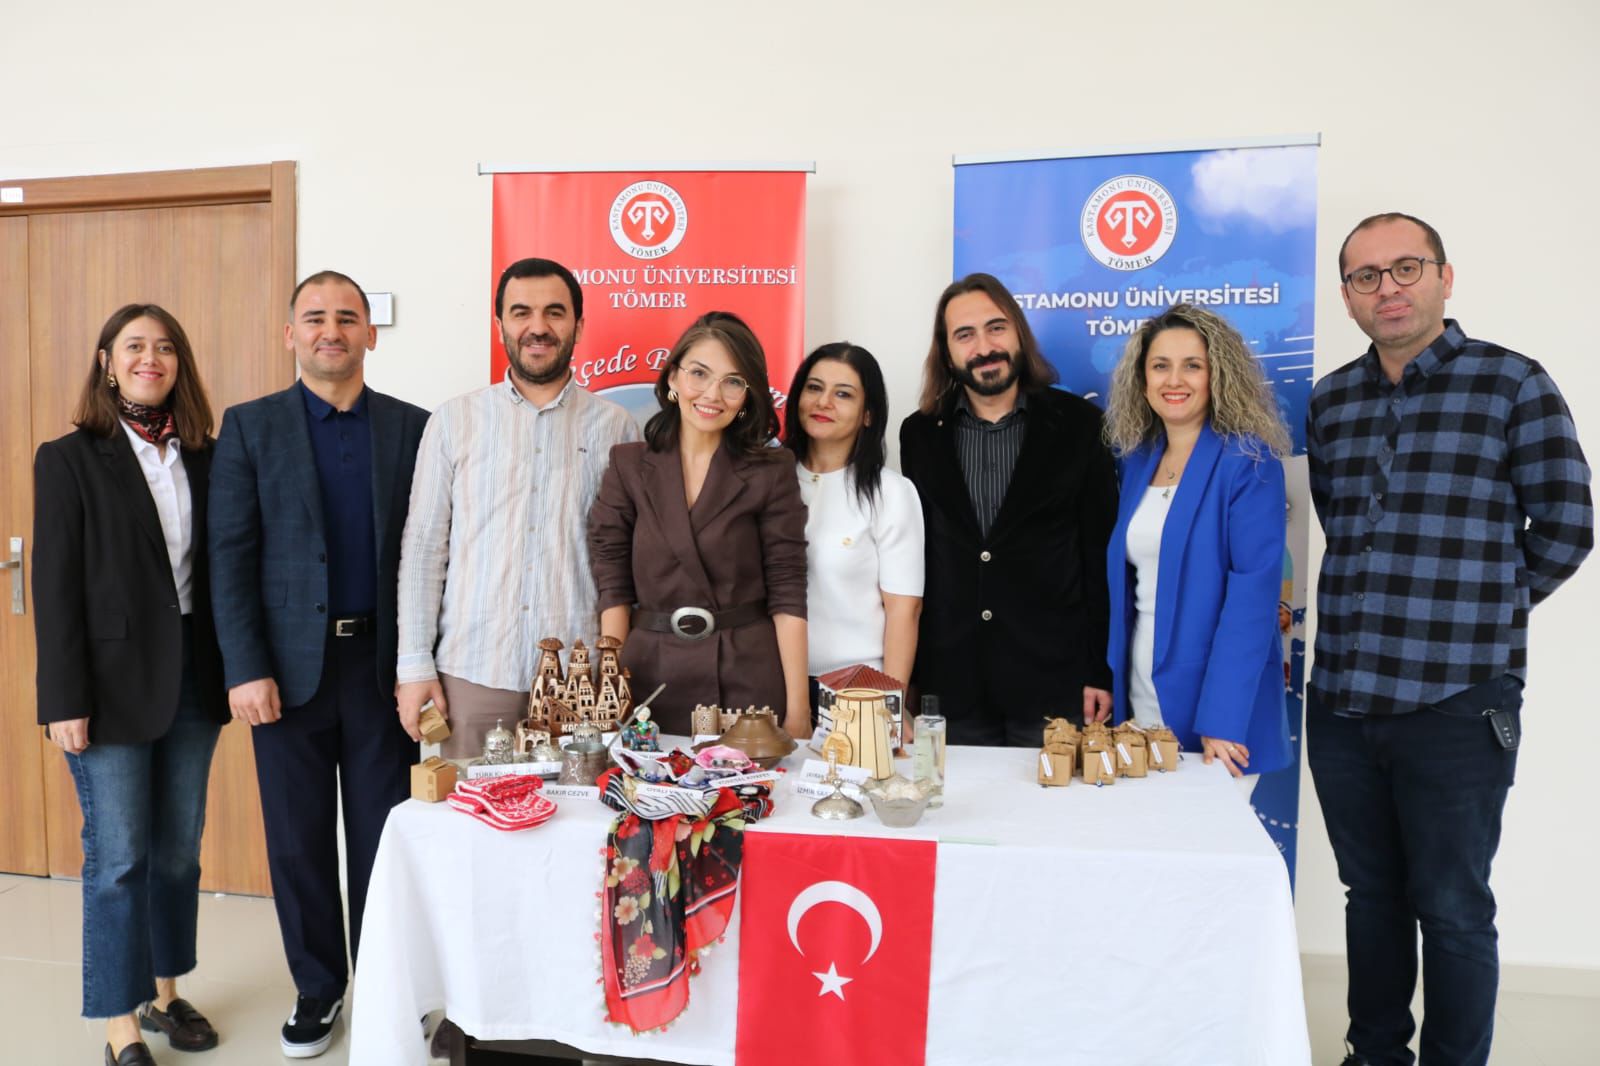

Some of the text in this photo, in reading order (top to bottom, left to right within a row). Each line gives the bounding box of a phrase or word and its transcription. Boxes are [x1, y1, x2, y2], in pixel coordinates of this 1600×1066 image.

[612, 184, 643, 230] KASTAMONU
[1087, 179, 1173, 237] KASTAMONU ÜNİVERSİTESİ
[631, 246, 668, 257] TÖMER
[1108, 255, 1153, 269] TÖMER
[643, 265, 798, 285] ÜNİVERSİTESİ
[609, 289, 687, 308] TÖMER
[1013, 282, 1280, 310] STAMONU ÜNİVERSİTESİ
[1086, 315, 1147, 336] TÖM
[572, 345, 637, 387] çede
